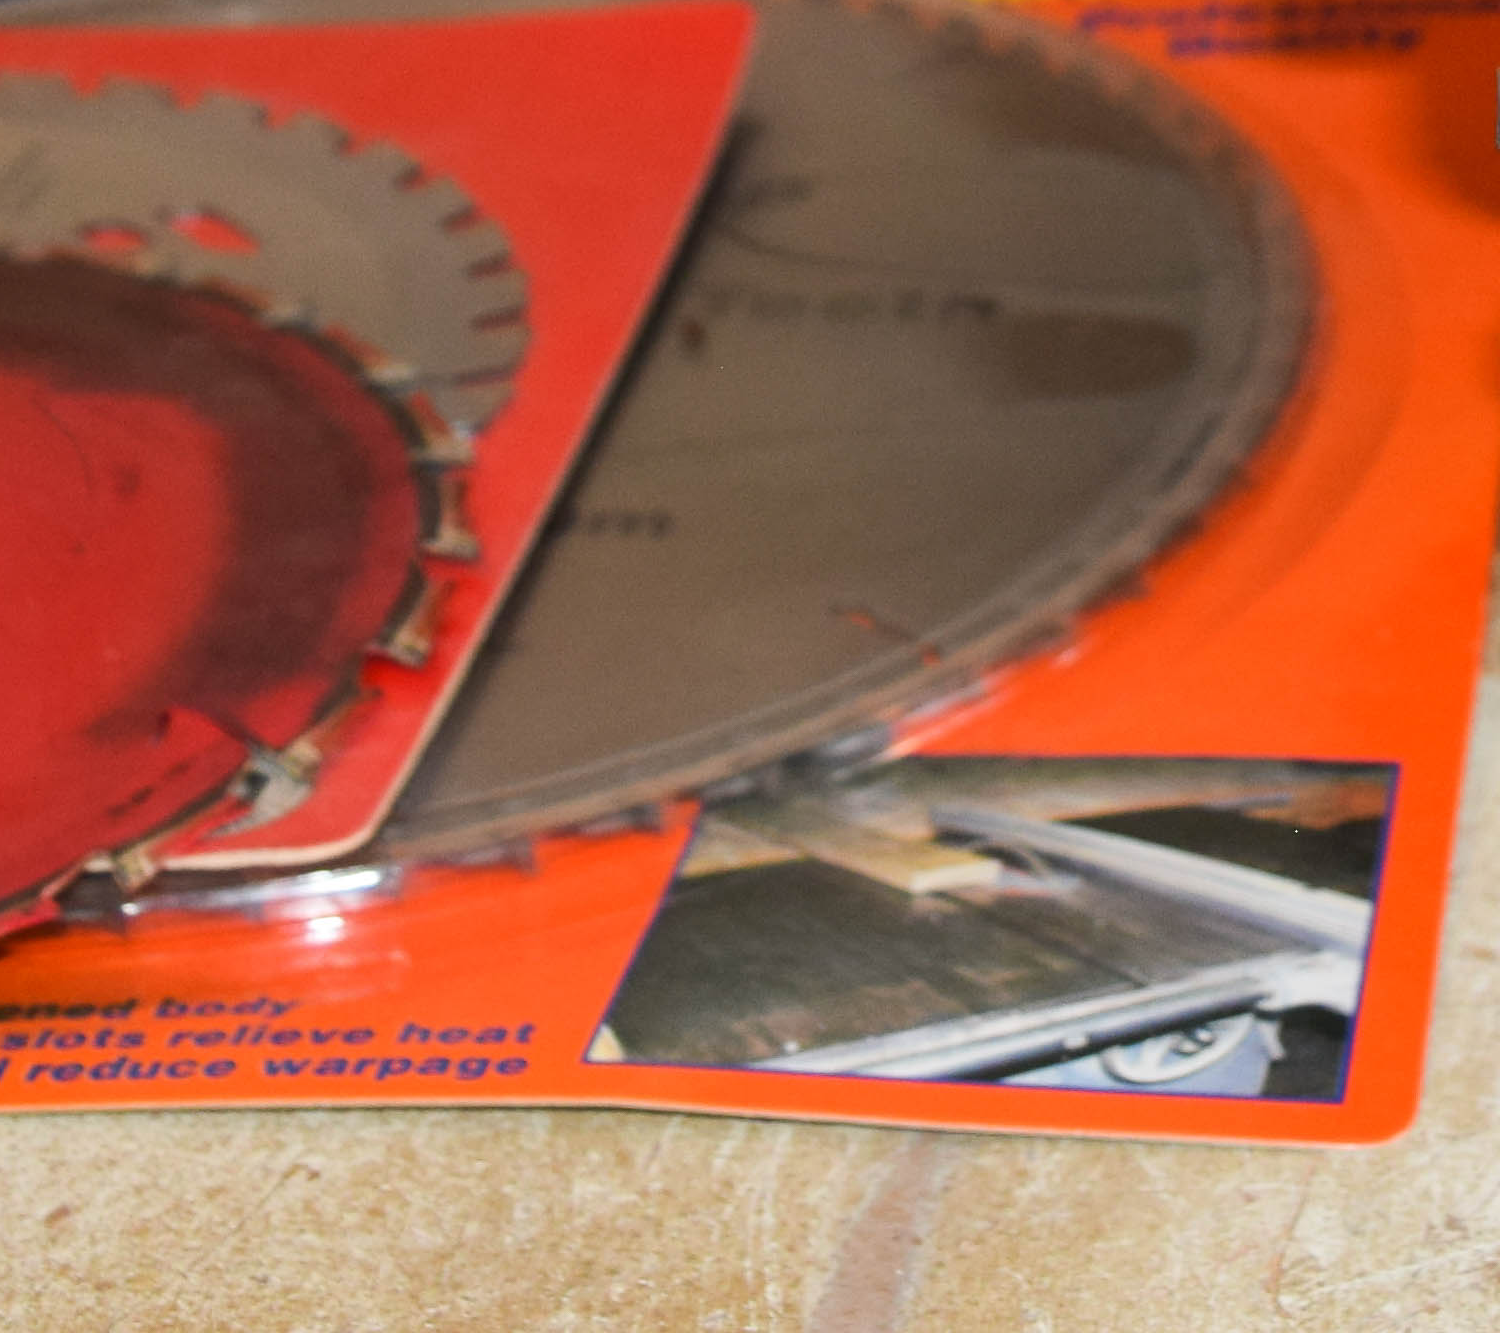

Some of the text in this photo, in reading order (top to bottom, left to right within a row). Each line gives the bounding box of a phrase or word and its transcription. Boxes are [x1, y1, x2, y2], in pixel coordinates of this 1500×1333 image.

[155, 997, 298, 1023] body
[0, 1027, 158, 1051] slots
[167, 1022, 375, 1049] relieve
[398, 1021, 536, 1046] heat
[25, 1055, 237, 1082] reduce
[263, 1055, 530, 1082] warpage
